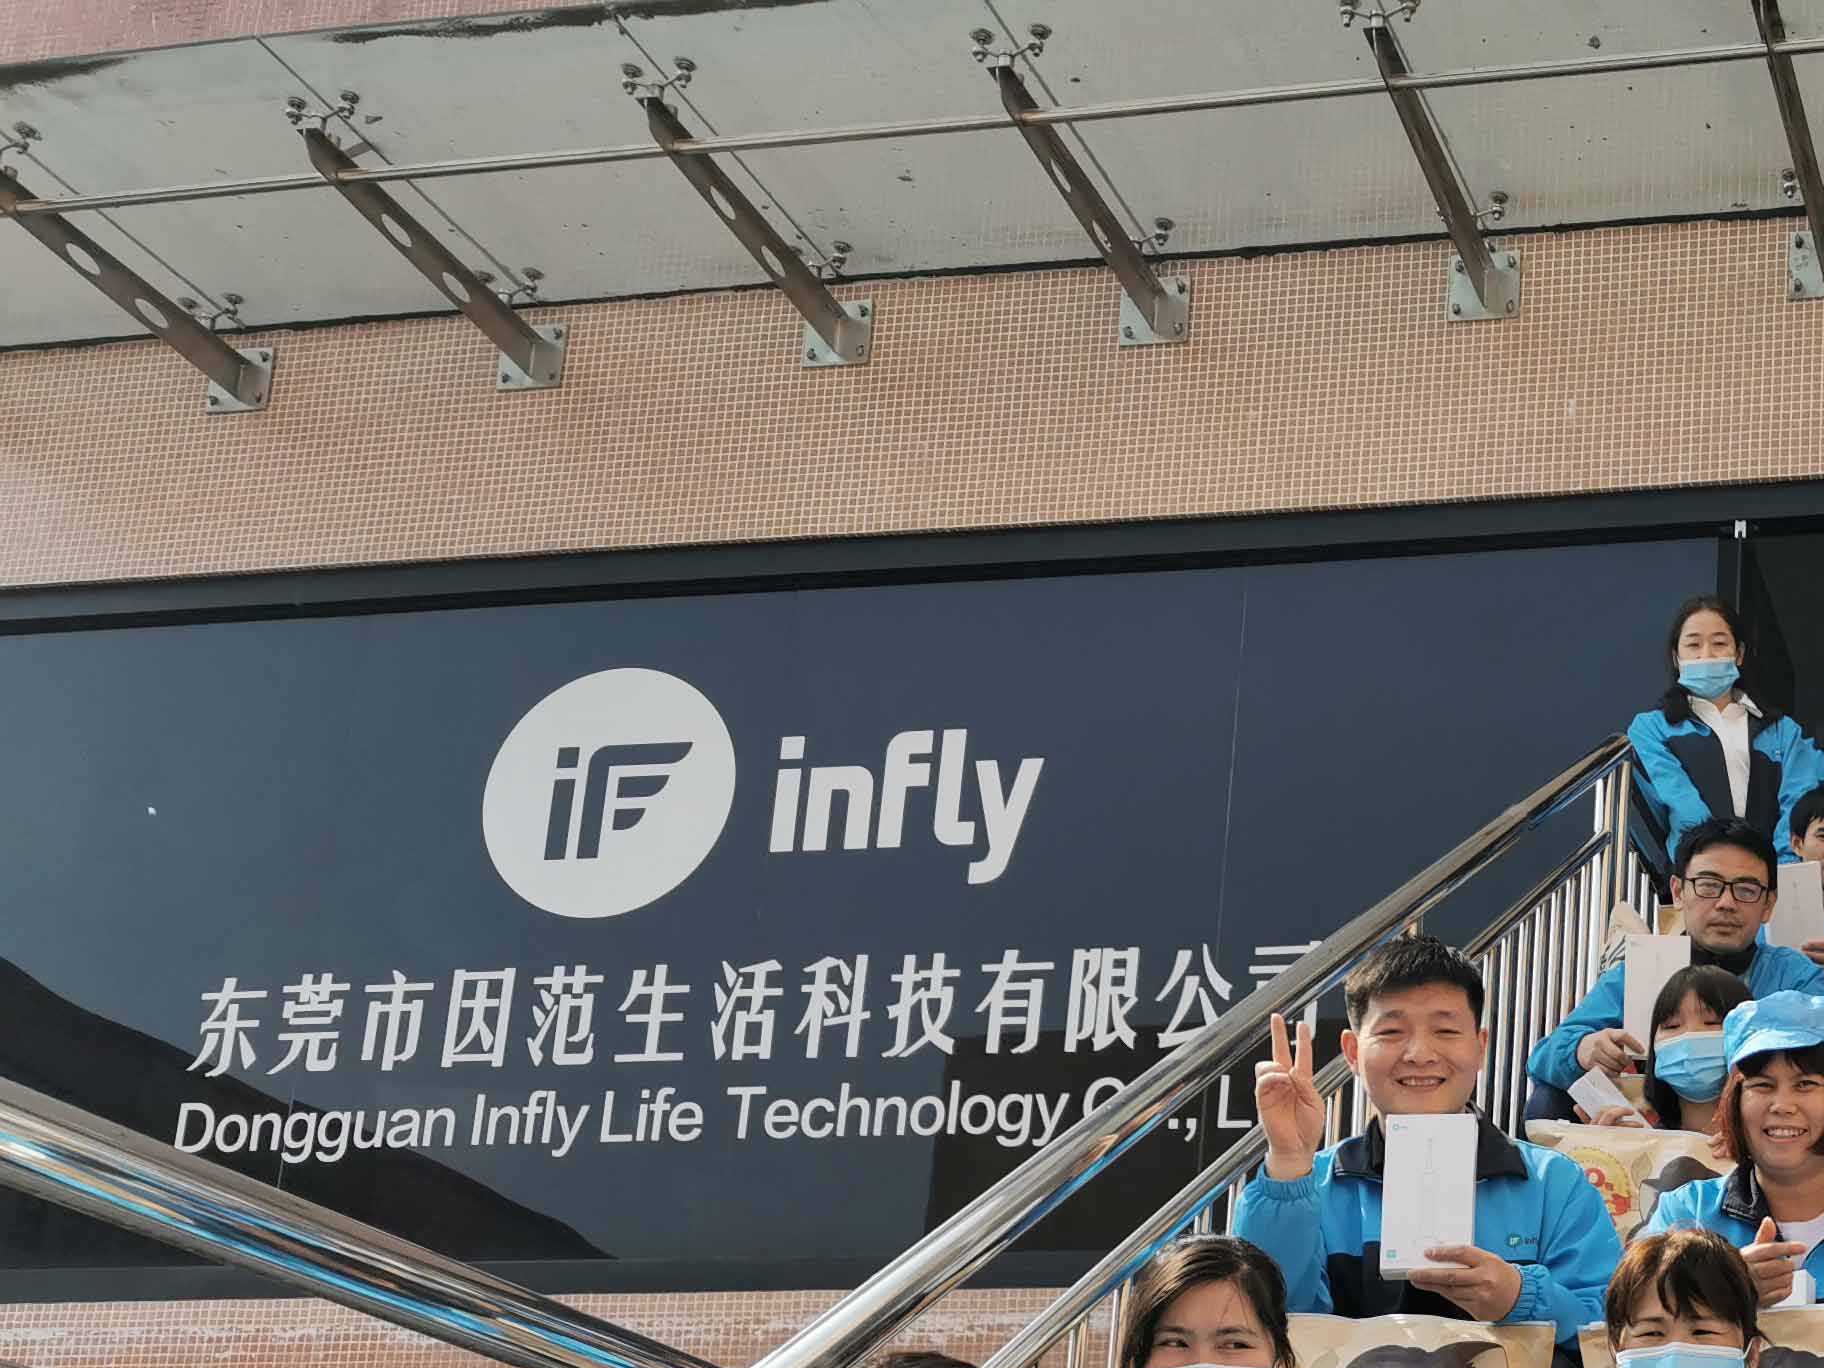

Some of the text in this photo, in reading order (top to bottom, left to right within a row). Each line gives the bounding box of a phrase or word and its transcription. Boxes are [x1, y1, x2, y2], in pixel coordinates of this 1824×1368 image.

[768, 728, 1046, 885] infly
[174, 1101, 456, 1164] Dongguan
[470, 1089, 590, 1159] Infly
[599, 1087, 704, 1144] Life
[726, 1080, 1070, 1147] Technology
